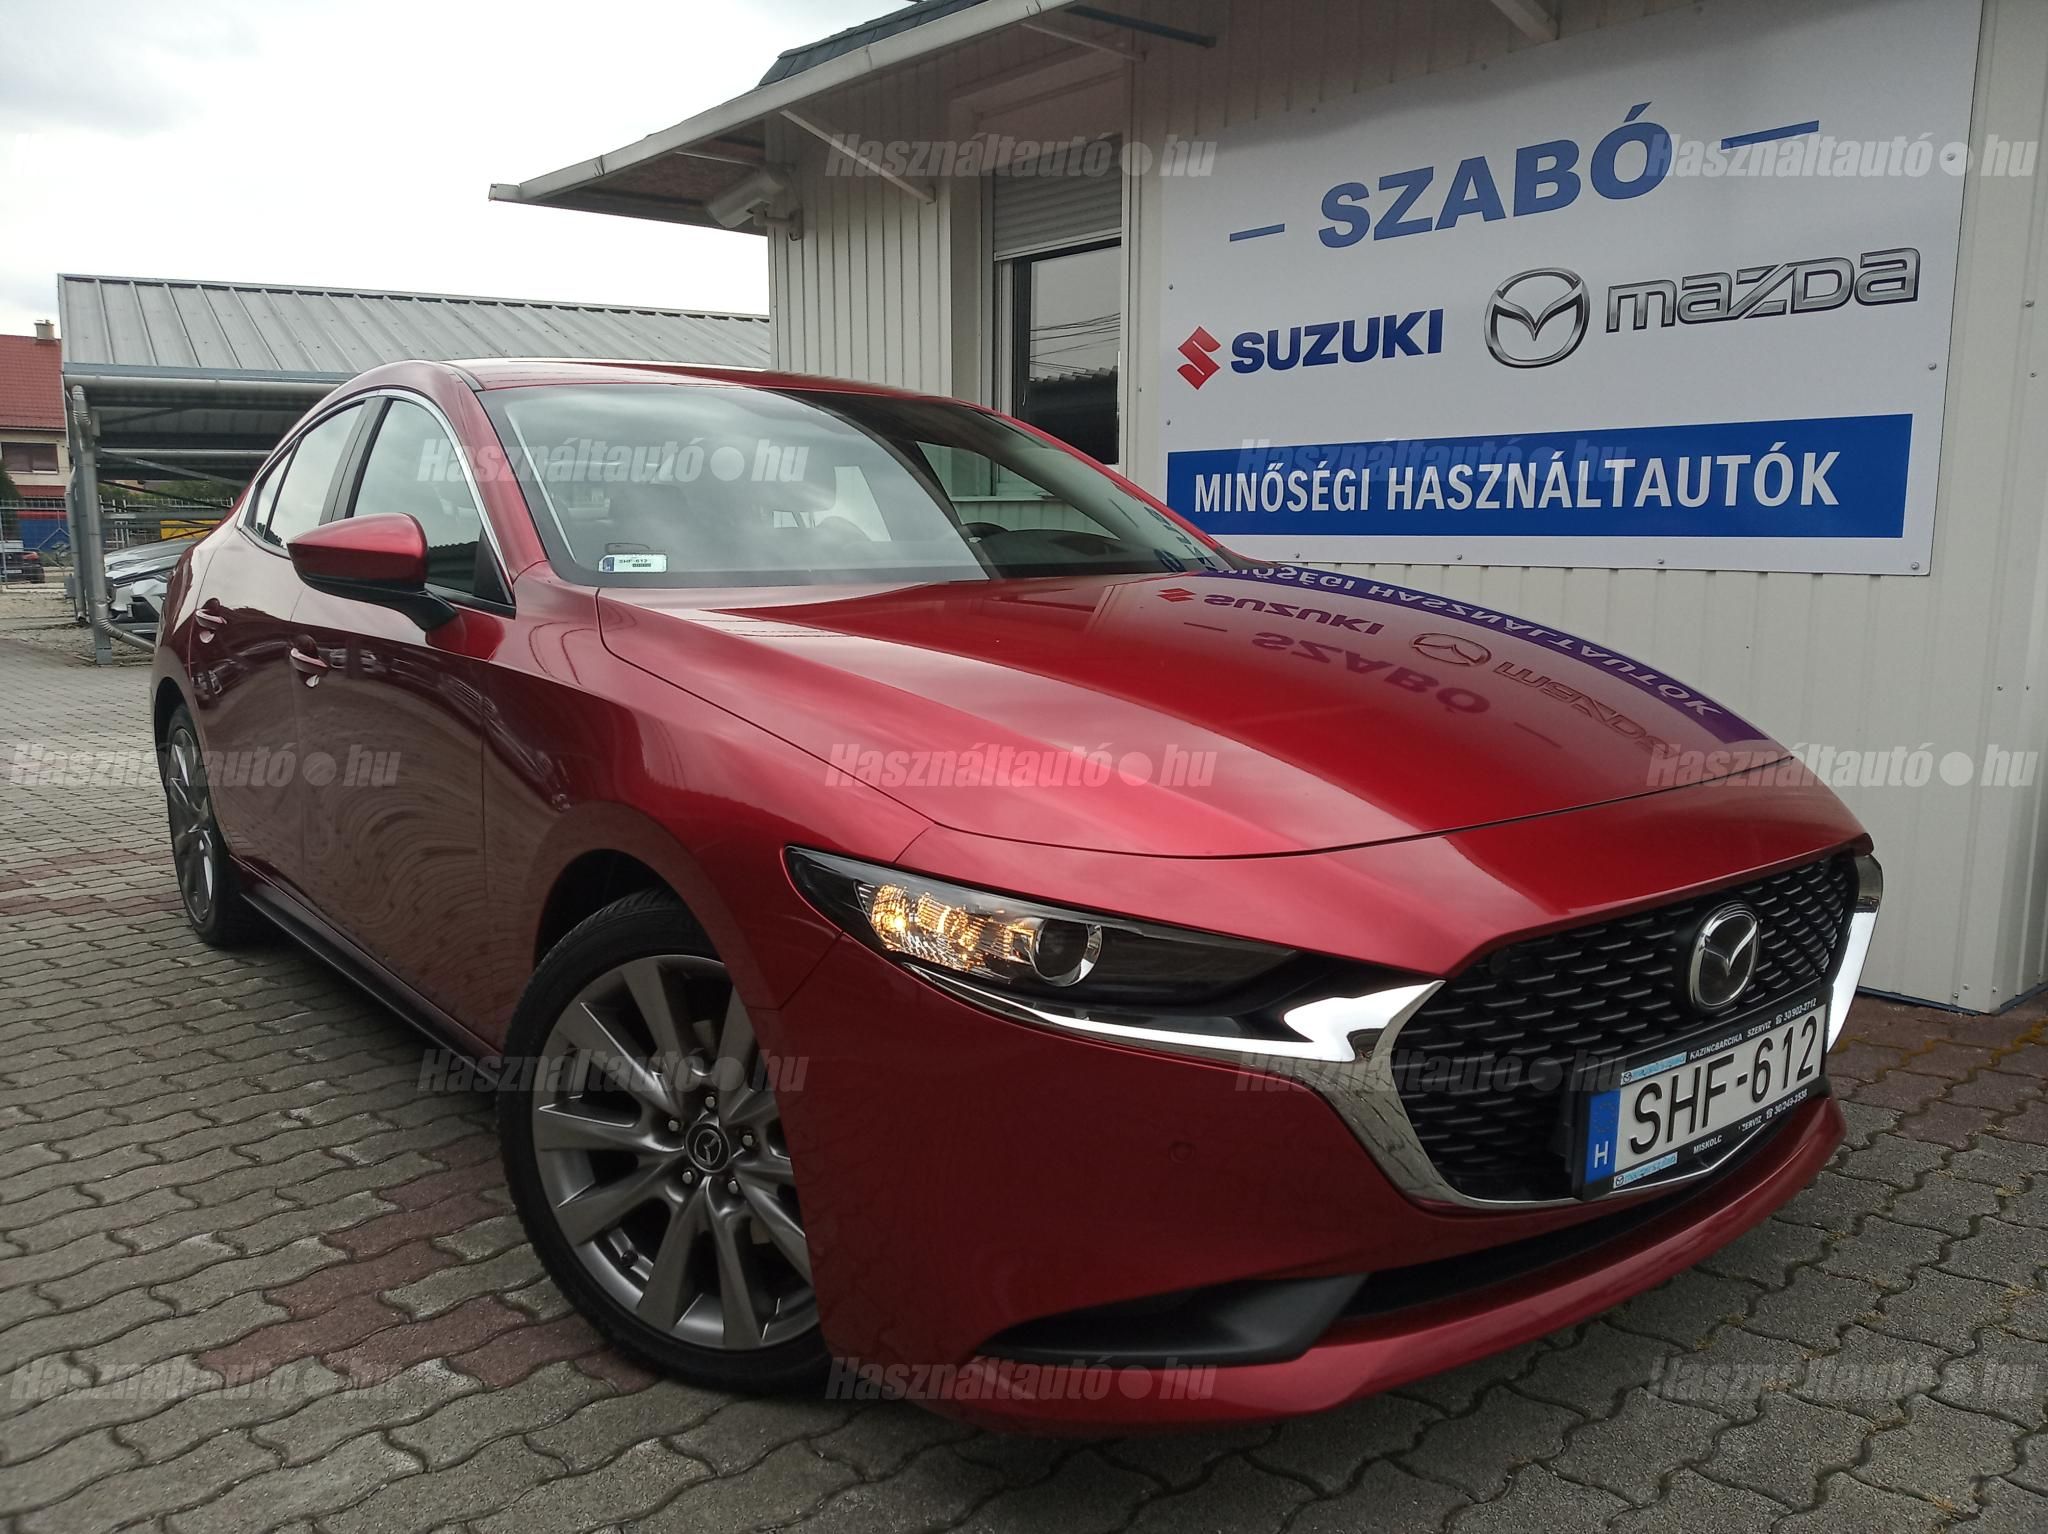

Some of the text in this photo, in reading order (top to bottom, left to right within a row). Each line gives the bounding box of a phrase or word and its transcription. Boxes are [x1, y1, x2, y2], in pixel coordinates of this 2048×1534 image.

[1316, 101, 1673, 249] SZABÓ
[1605, 247, 1920, 333] mazda
[1230, 308, 1444, 374] SUZUKI
[1194, 441, 1841, 514] MINŐSÉGI HASZNÁLTAUTÓK
[1629, 1015, 1818, 1155] SHF-612
[1594, 1140, 1610, 1169] H
